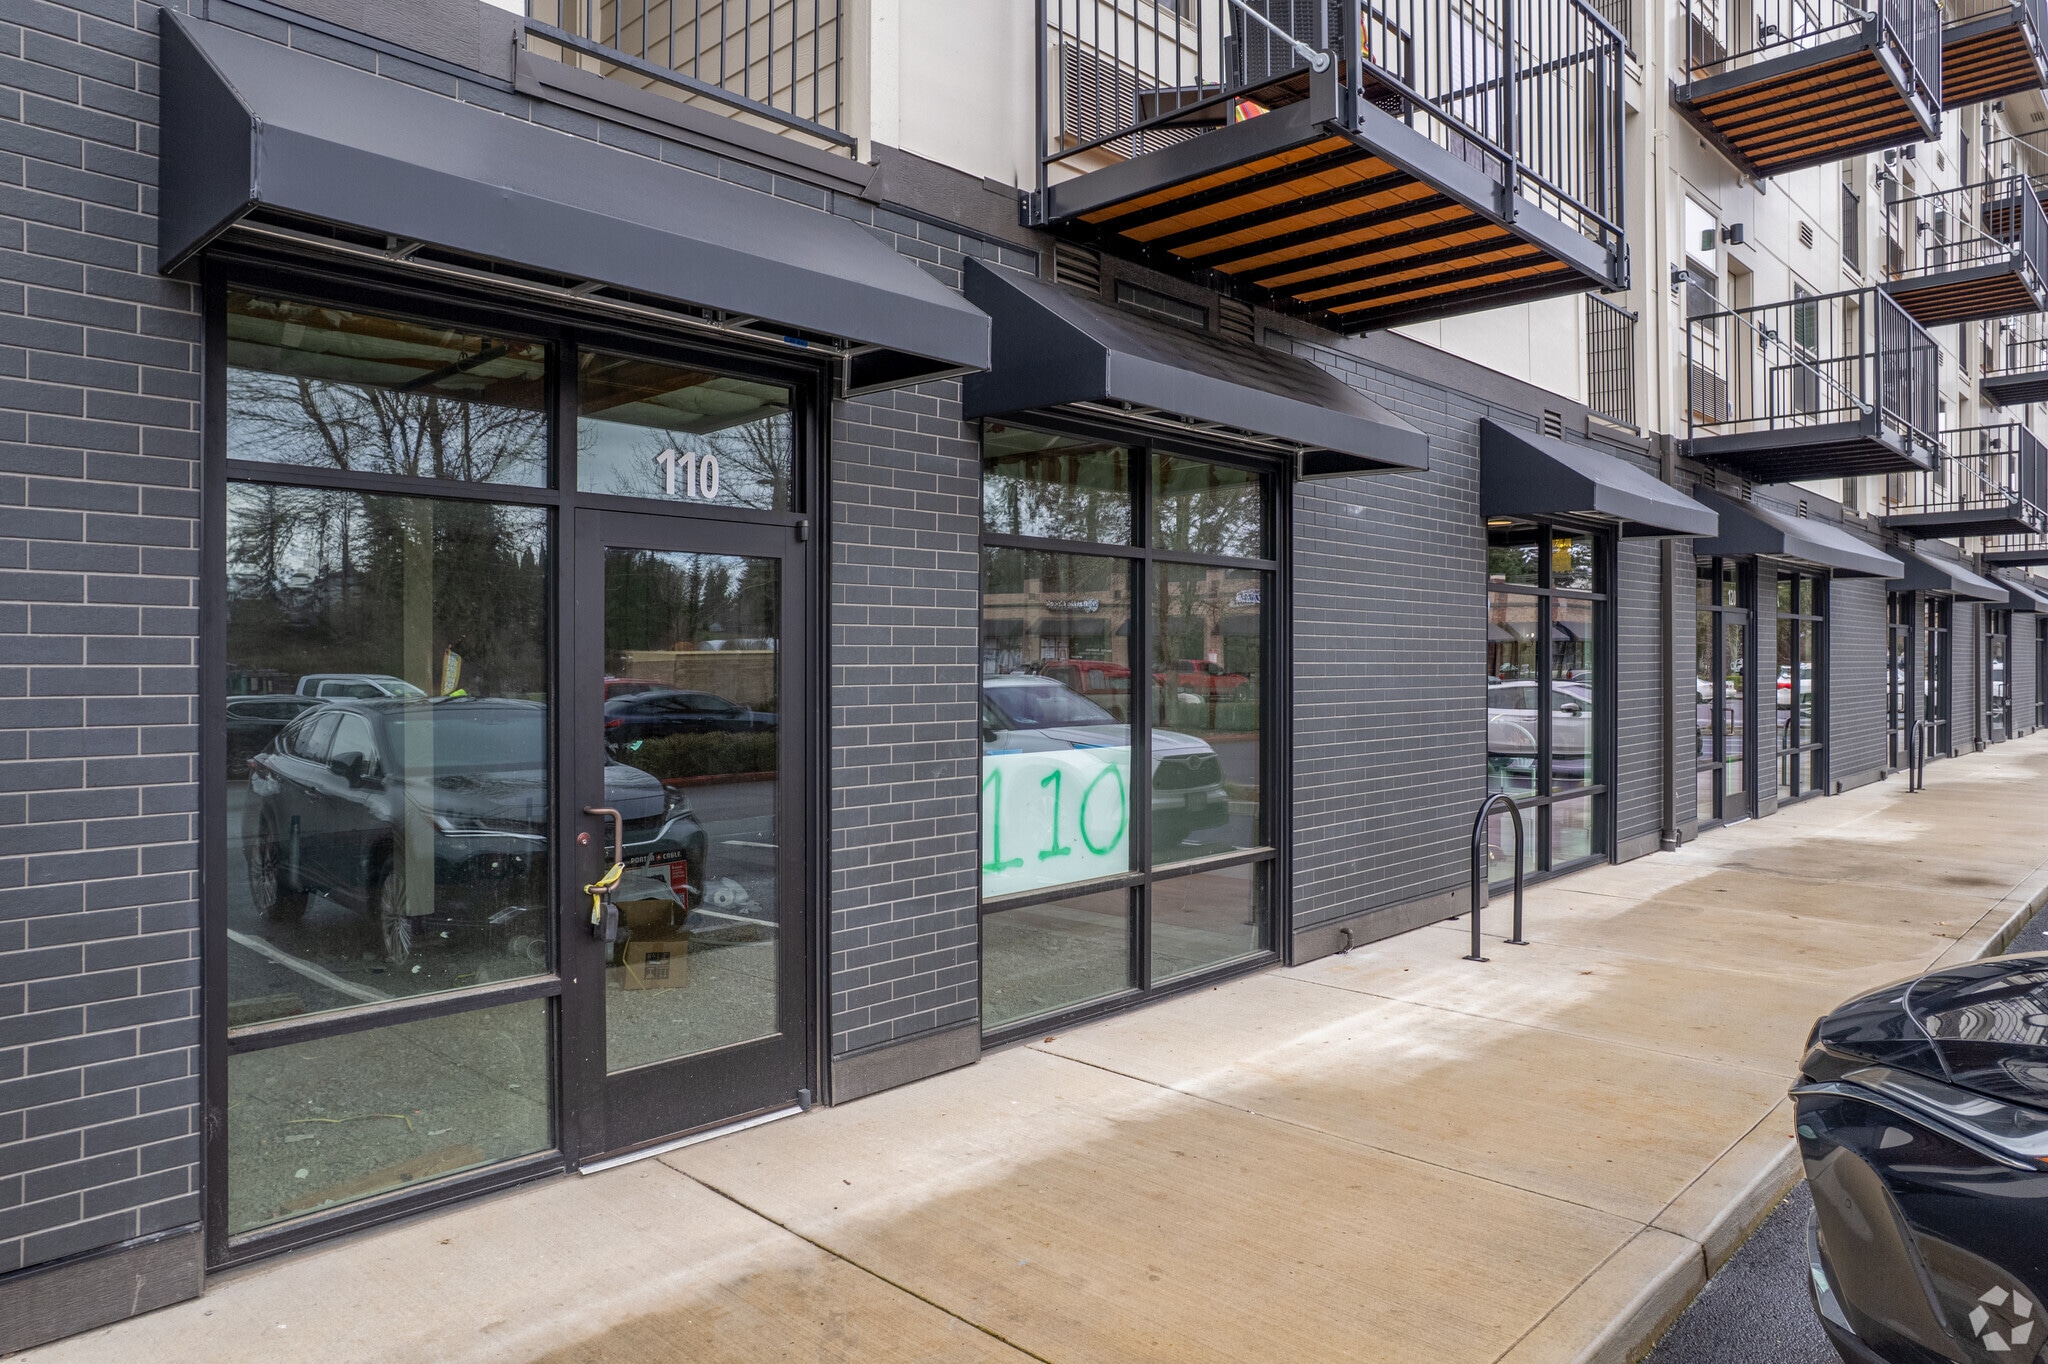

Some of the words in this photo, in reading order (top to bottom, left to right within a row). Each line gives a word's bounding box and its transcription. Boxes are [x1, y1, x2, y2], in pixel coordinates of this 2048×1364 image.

[656, 448, 720, 499] 110
[1728, 589, 1737, 606] 120
[982, 763, 1127, 872] 110
[630, 855, 655, 864] PORTR
